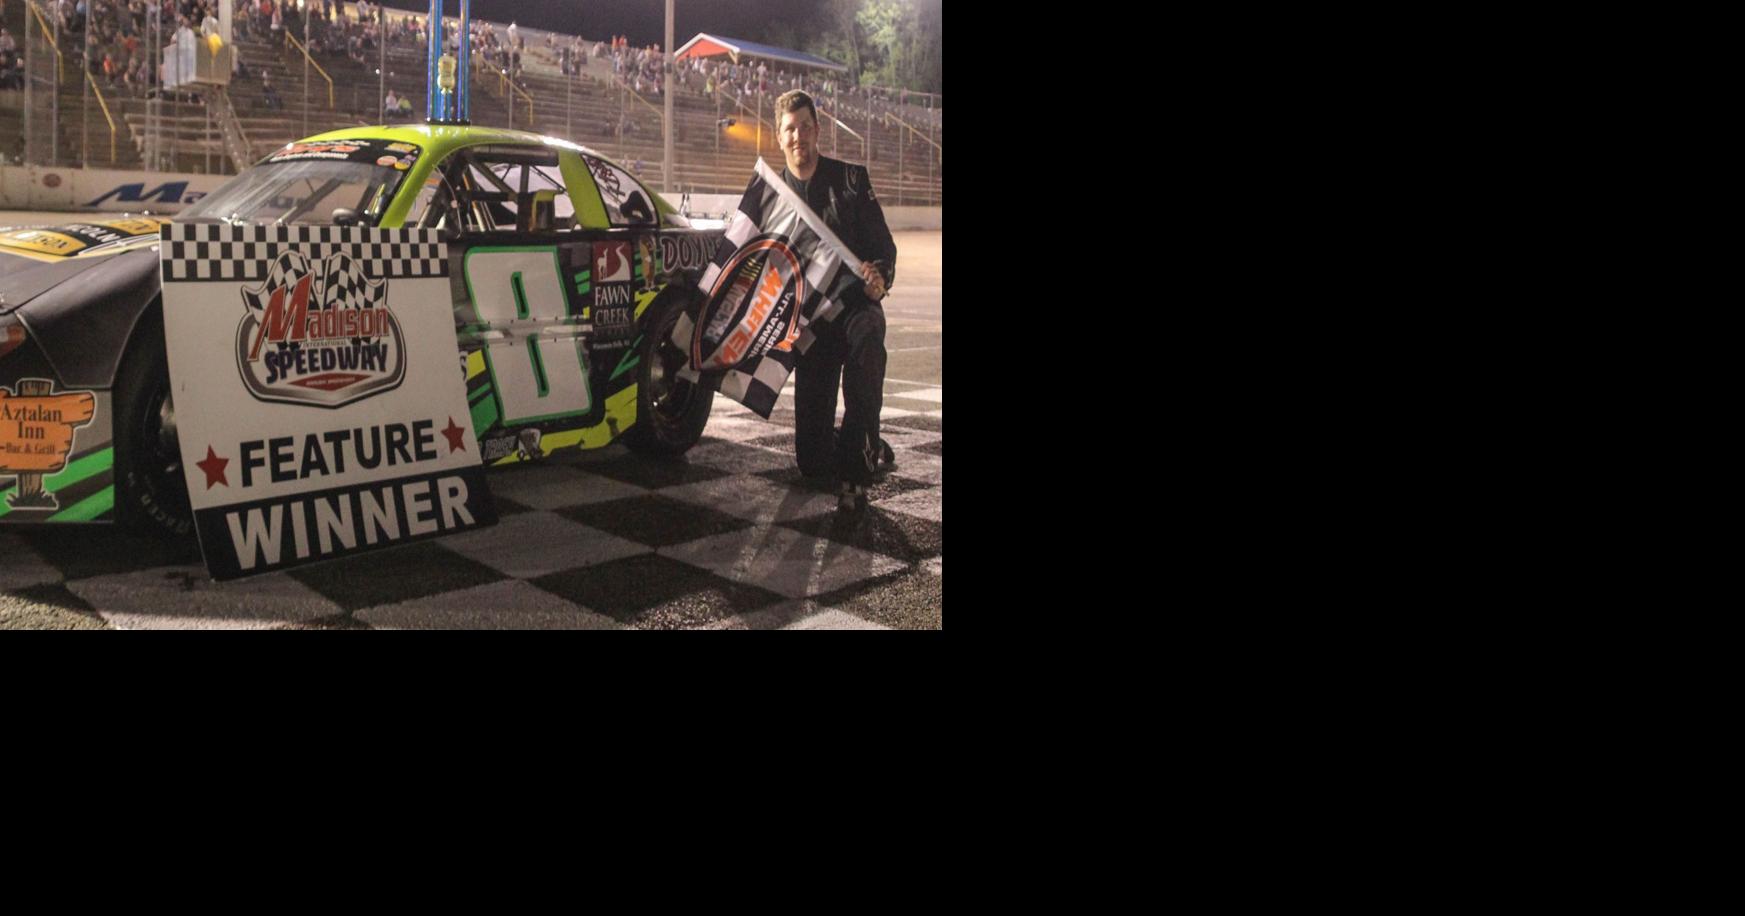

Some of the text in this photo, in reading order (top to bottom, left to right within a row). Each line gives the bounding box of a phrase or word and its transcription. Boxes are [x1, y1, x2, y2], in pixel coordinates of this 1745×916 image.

[595, 285, 630, 306] FAWN
[247, 270, 390, 362] Madison
[595, 307, 629, 326] CREEK
[465, 247, 591, 426] 8
[265, 344, 388, 384] SPEEDWAY
[0, 403, 62, 422] Aztalan
[18, 421, 45, 439] Inn
[240, 419, 438, 487] FEATURE
[226, 475, 475, 570] WINNER
